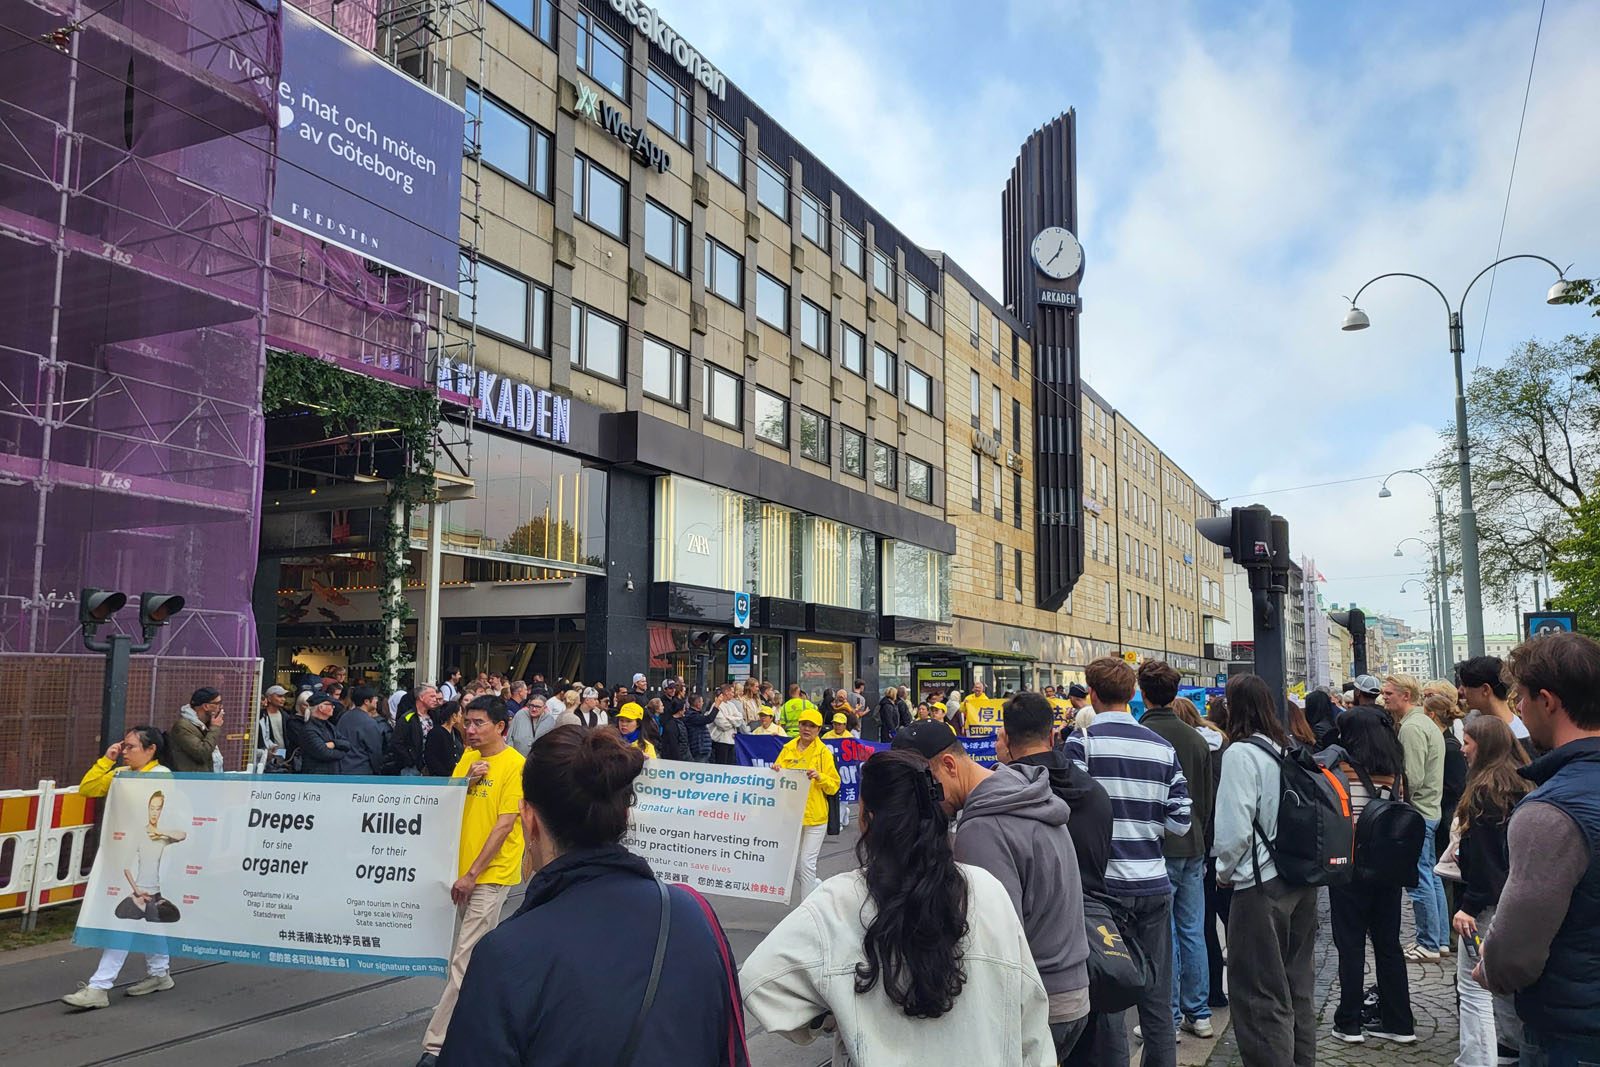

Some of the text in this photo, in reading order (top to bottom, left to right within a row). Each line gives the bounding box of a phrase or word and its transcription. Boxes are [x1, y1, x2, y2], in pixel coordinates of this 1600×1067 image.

[609, 0, 726, 101] asakronan
[229, 49, 437, 176] Moe, mat och möten
[299, 122, 415, 195] av Göteborg
[1041, 290, 1076, 305] ARKADEN
[437, 356, 571, 445] ARKADEN
[737, 599, 747, 611] C2
[733, 644, 747, 656] C2
[970, 727, 993, 735] STOPP
[969, 753, 998, 762] Harvest
[640, 766, 798, 791] ngen organhøsting fra
[250, 790, 272, 800] Falun
[274, 791, 296, 802] Gong
[302, 791, 321, 801] Kina
[351, 793, 439, 806] Falun Gong in China
[634, 781, 776, 807] Gong-utøvere i Kina
[636, 801, 746, 823] ignatur kan redde liv
[248, 808, 315, 834] Drepes
[361, 812, 422, 836] Killed
[640, 823, 657, 835] live
[659, 827, 691, 840] organ
[693, 831, 750, 849] harvesting
[752, 836, 779, 849] from
[262, 839, 293, 850] for sine
[371, 844, 407, 856] for their
[649, 840, 718, 858] practitioners
[720, 850, 731, 859] in
[733, 850, 766, 863] China
[242, 857, 309, 876] organer
[673, 860, 688, 868] can
[690, 861, 710, 871] save
[711, 864, 732, 874] lives
[355, 864, 417, 884] organs
[654, 870, 689, 883] 学员器官
[243, 889, 281, 899] Organturisme
[265, 901, 277, 909] stor
[278, 902, 293, 910] skala
[346, 898, 366, 907] Organ
[367, 899, 391, 908] tourism
[400, 901, 421, 910] China
[353, 909, 372, 918] Large
[392, 911, 413, 921] killing
[355, 918, 413, 929] State sanctioned
[182, 943, 193, 953] Din
[193, 945, 219, 956] signatur
[219, 947, 231, 957] kan
[232, 948, 251, 959] redde
[357, 959, 374, 969] Your
[375, 960, 411, 972] signature
[411, 963, 427, 971] can
